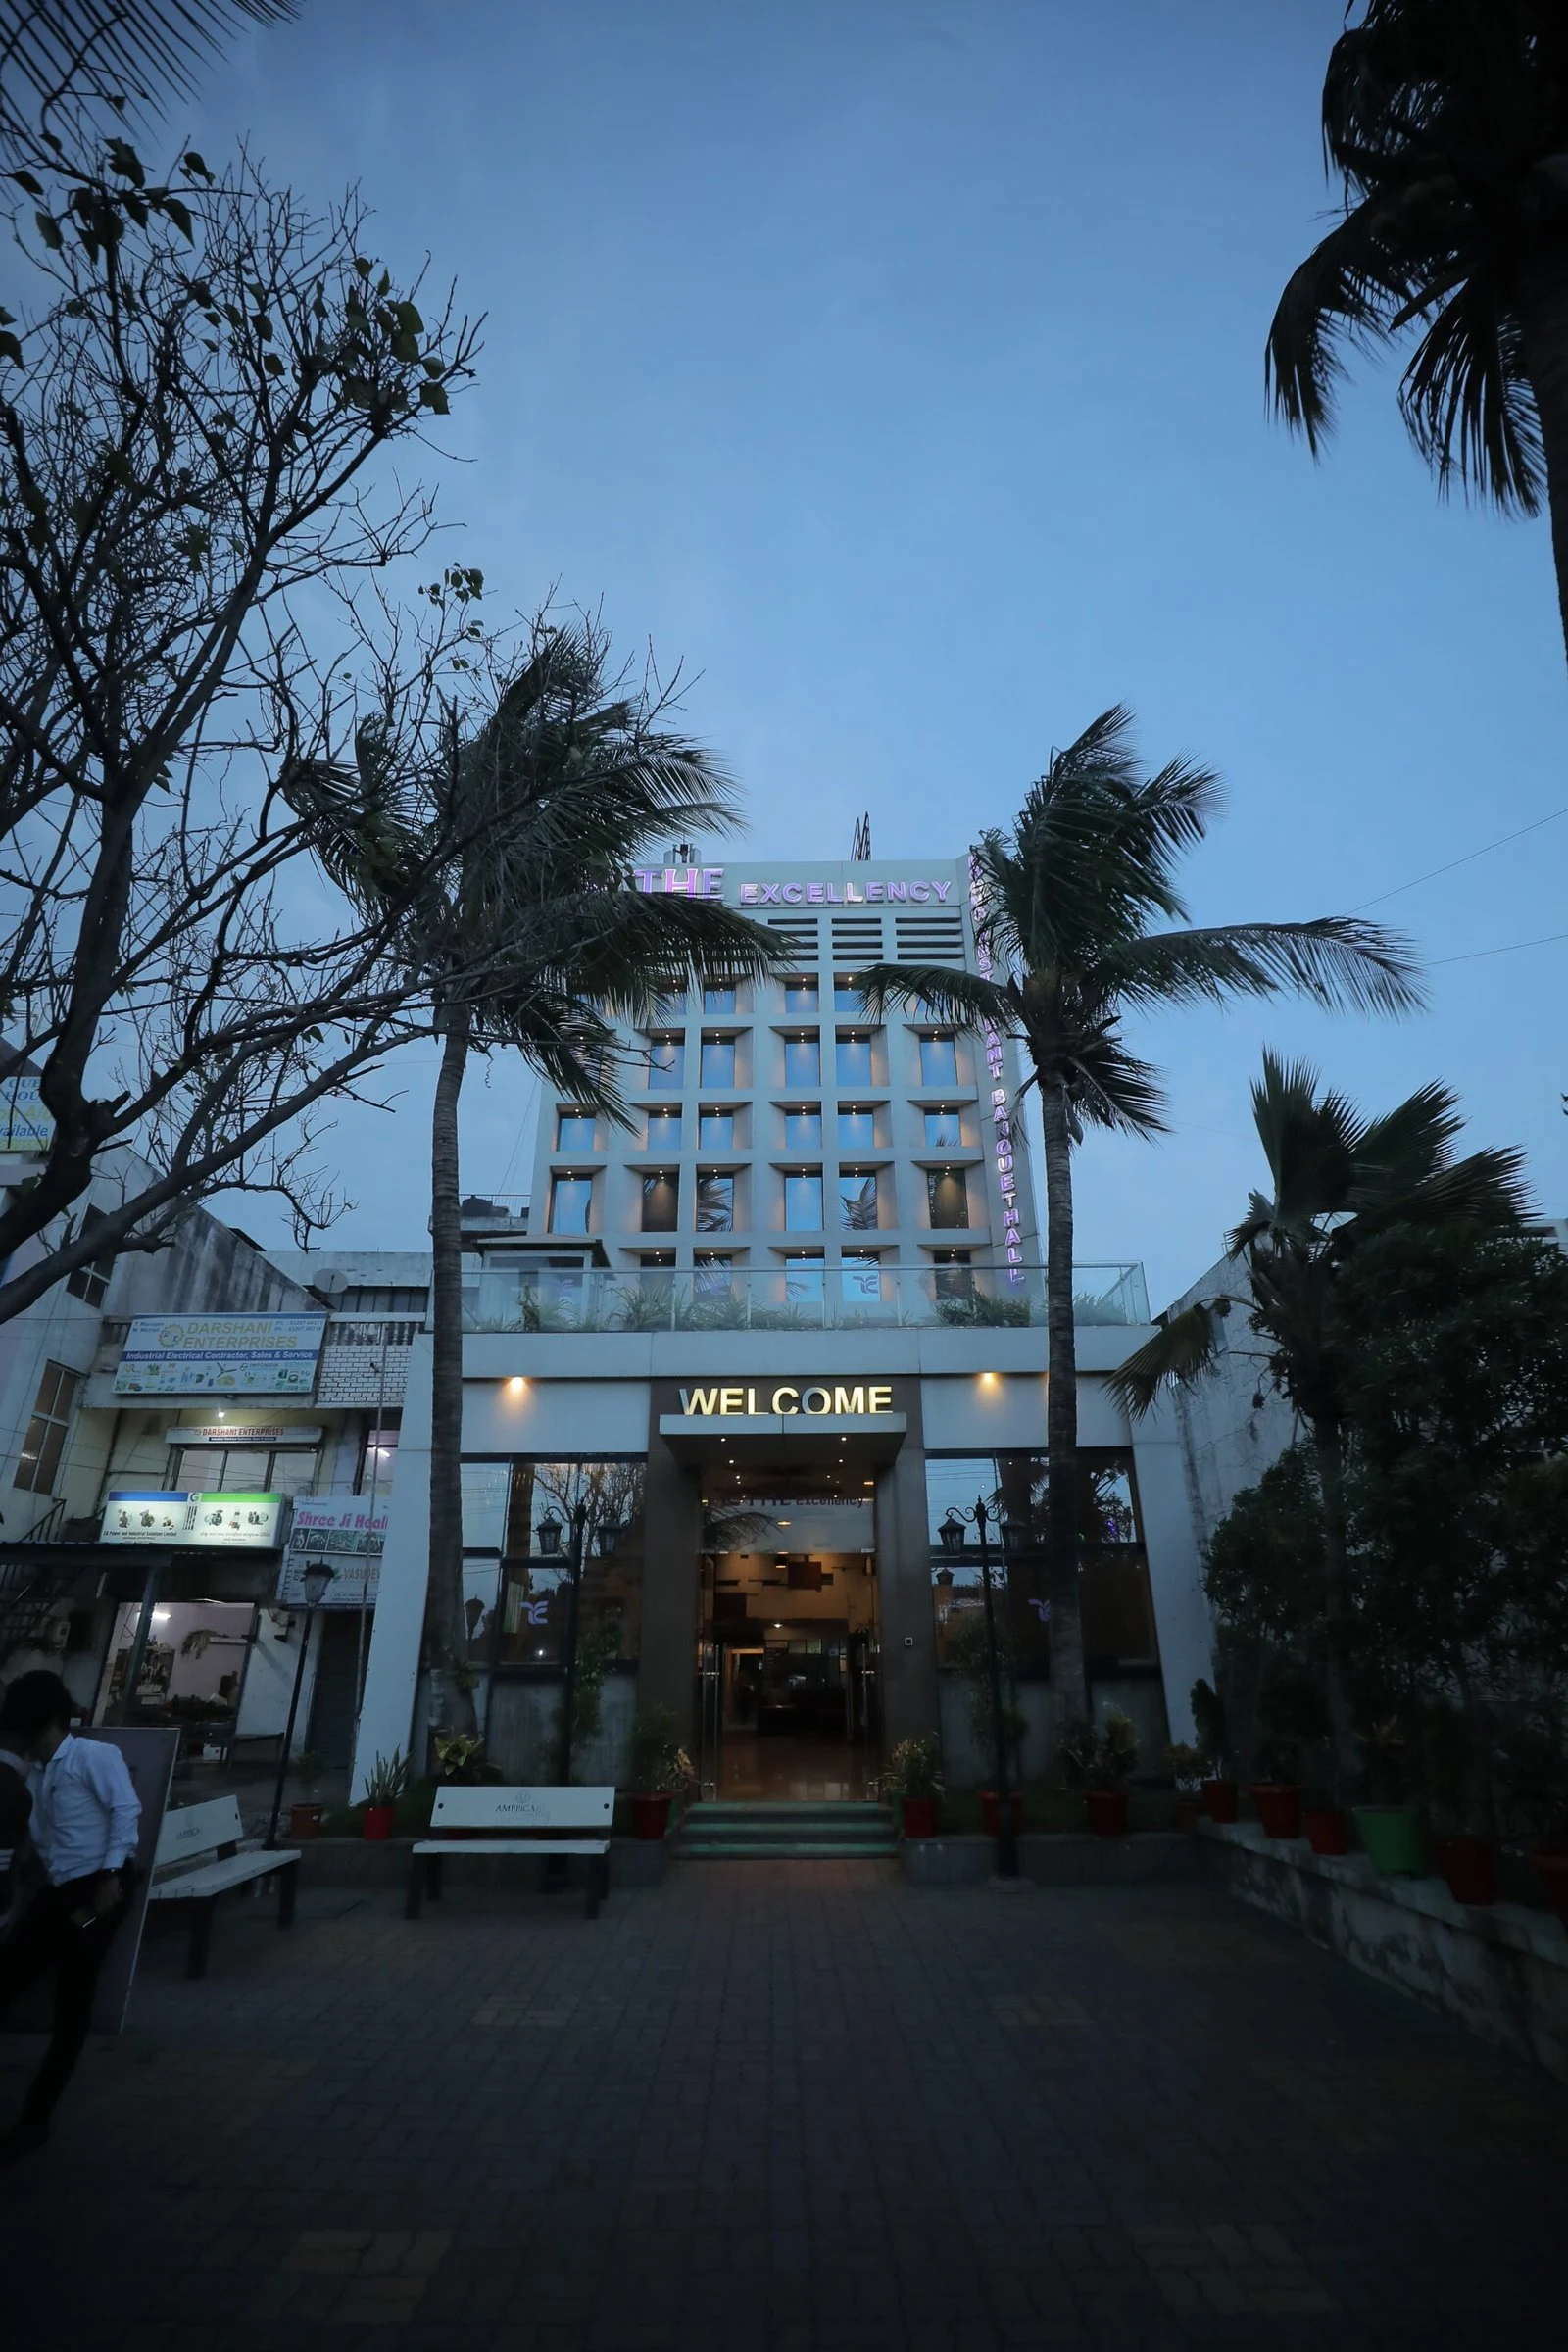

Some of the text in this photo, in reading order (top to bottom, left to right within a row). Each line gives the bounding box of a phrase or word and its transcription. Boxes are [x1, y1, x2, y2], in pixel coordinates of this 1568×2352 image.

[634, 868, 951, 904] THE EXCELLENCY
[186, 1321, 273, 1335] DARSHANI
[183, 1336, 298, 1348] ENTERPRISES
[126, 1351, 165, 1360] Industrial
[166, 1351, 204, 1360] Electrical
[205, 1351, 249, 1360] Contractor,
[679, 1386, 894, 1416] WELCOME
[297, 1511, 336, 1526] Shree
[339, 1512, 352, 1528] Ji
